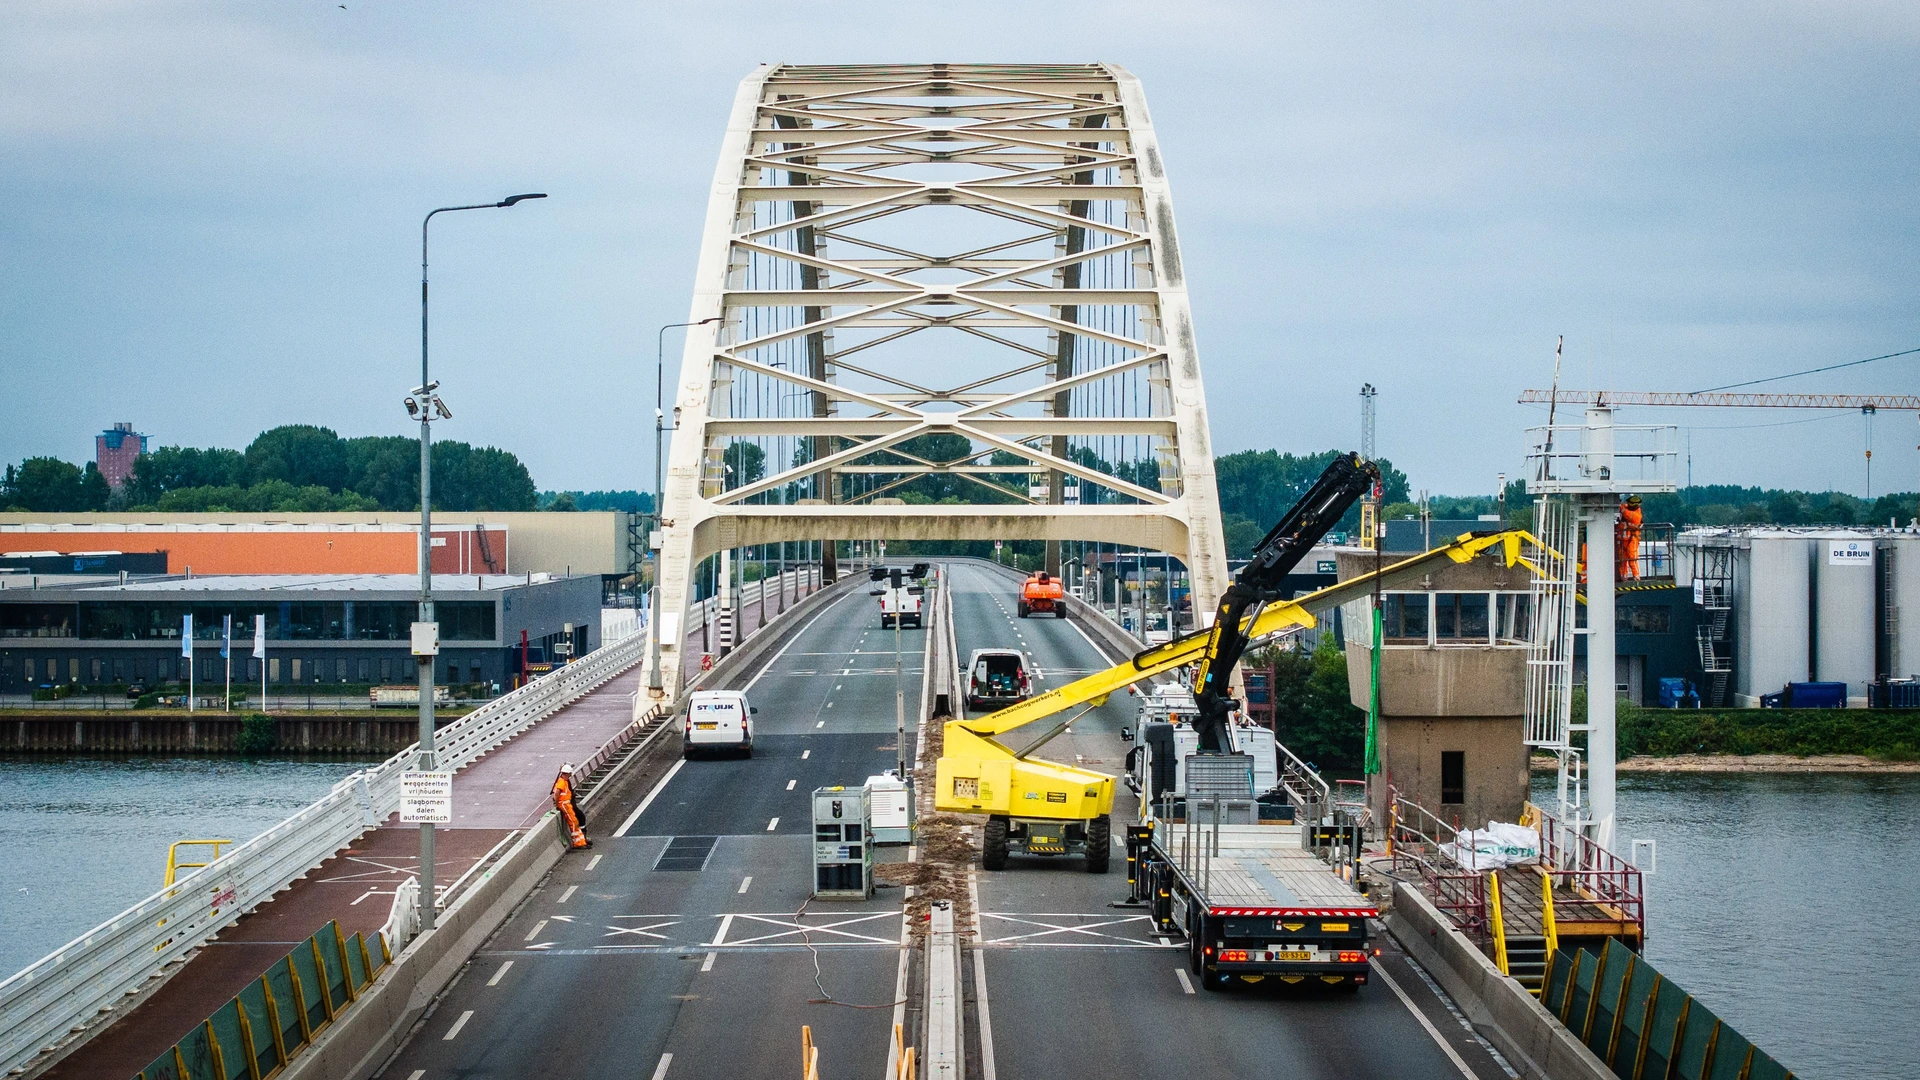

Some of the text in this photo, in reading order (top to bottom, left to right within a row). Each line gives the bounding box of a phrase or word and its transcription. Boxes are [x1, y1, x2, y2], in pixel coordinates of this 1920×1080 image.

[1196, 661, 1209, 692] PALFINGER
[697, 704, 734, 712] STRUIJK
[991, 690, 1061, 719] www.bachoogwerkers.nl
